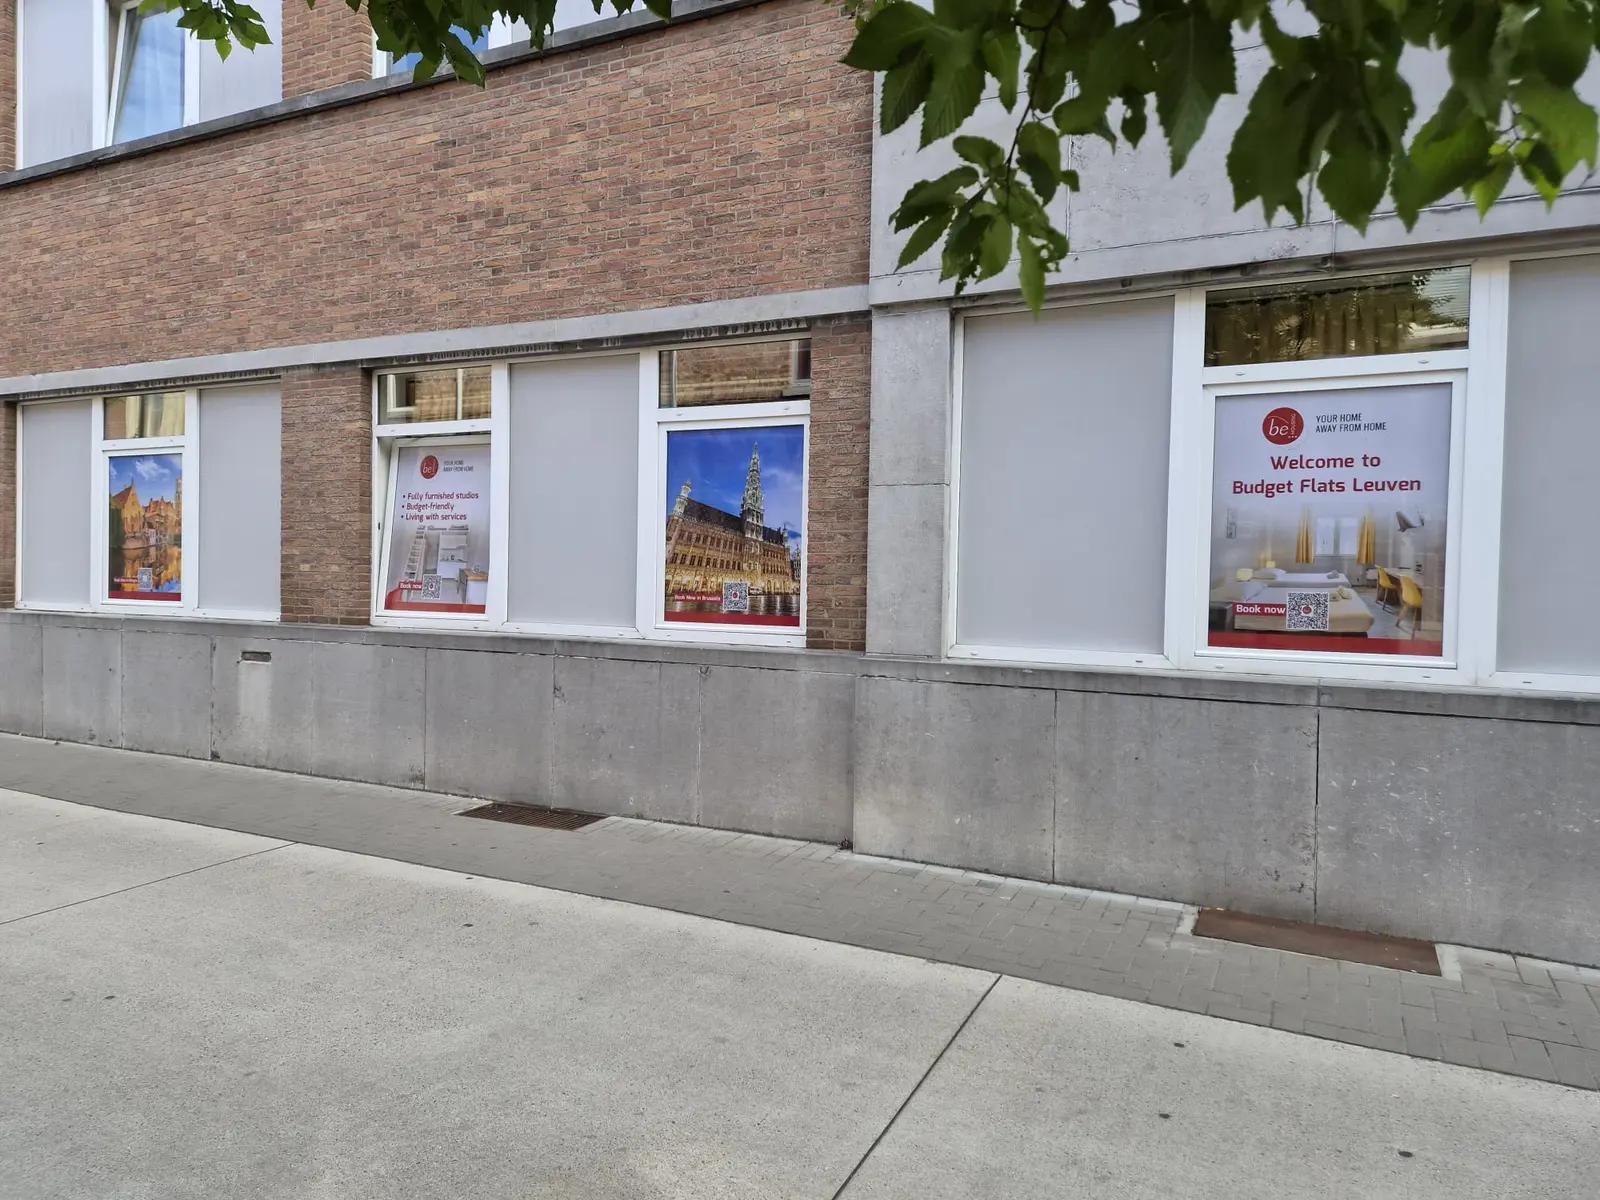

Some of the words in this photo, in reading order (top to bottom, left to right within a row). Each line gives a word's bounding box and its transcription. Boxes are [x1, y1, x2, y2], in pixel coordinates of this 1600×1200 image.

[1315, 414, 1338, 423] YOUR
[1340, 413, 1362, 422] HOME
[1268, 419, 1289, 436] be
[1315, 424, 1338, 433] AWAY
[1339, 423, 1361, 432] FROM
[1363, 422, 1387, 431] HOME
[1270, 454, 1355, 470] Welcome
[1361, 453, 1381, 467] to
[1232, 479, 1293, 498] Budget
[1300, 478, 1346, 493] Flats
[1352, 477, 1421, 492] Leuven
[407, 492, 423, 501] Fully
[425, 491, 454, 500] furnished
[455, 491, 479, 499] studios
[406, 502, 454, 512] Budget-friendly
[405, 513, 423, 522] Living
[1236, 604, 1261, 613] Book
[1264, 606, 1286, 614] now
